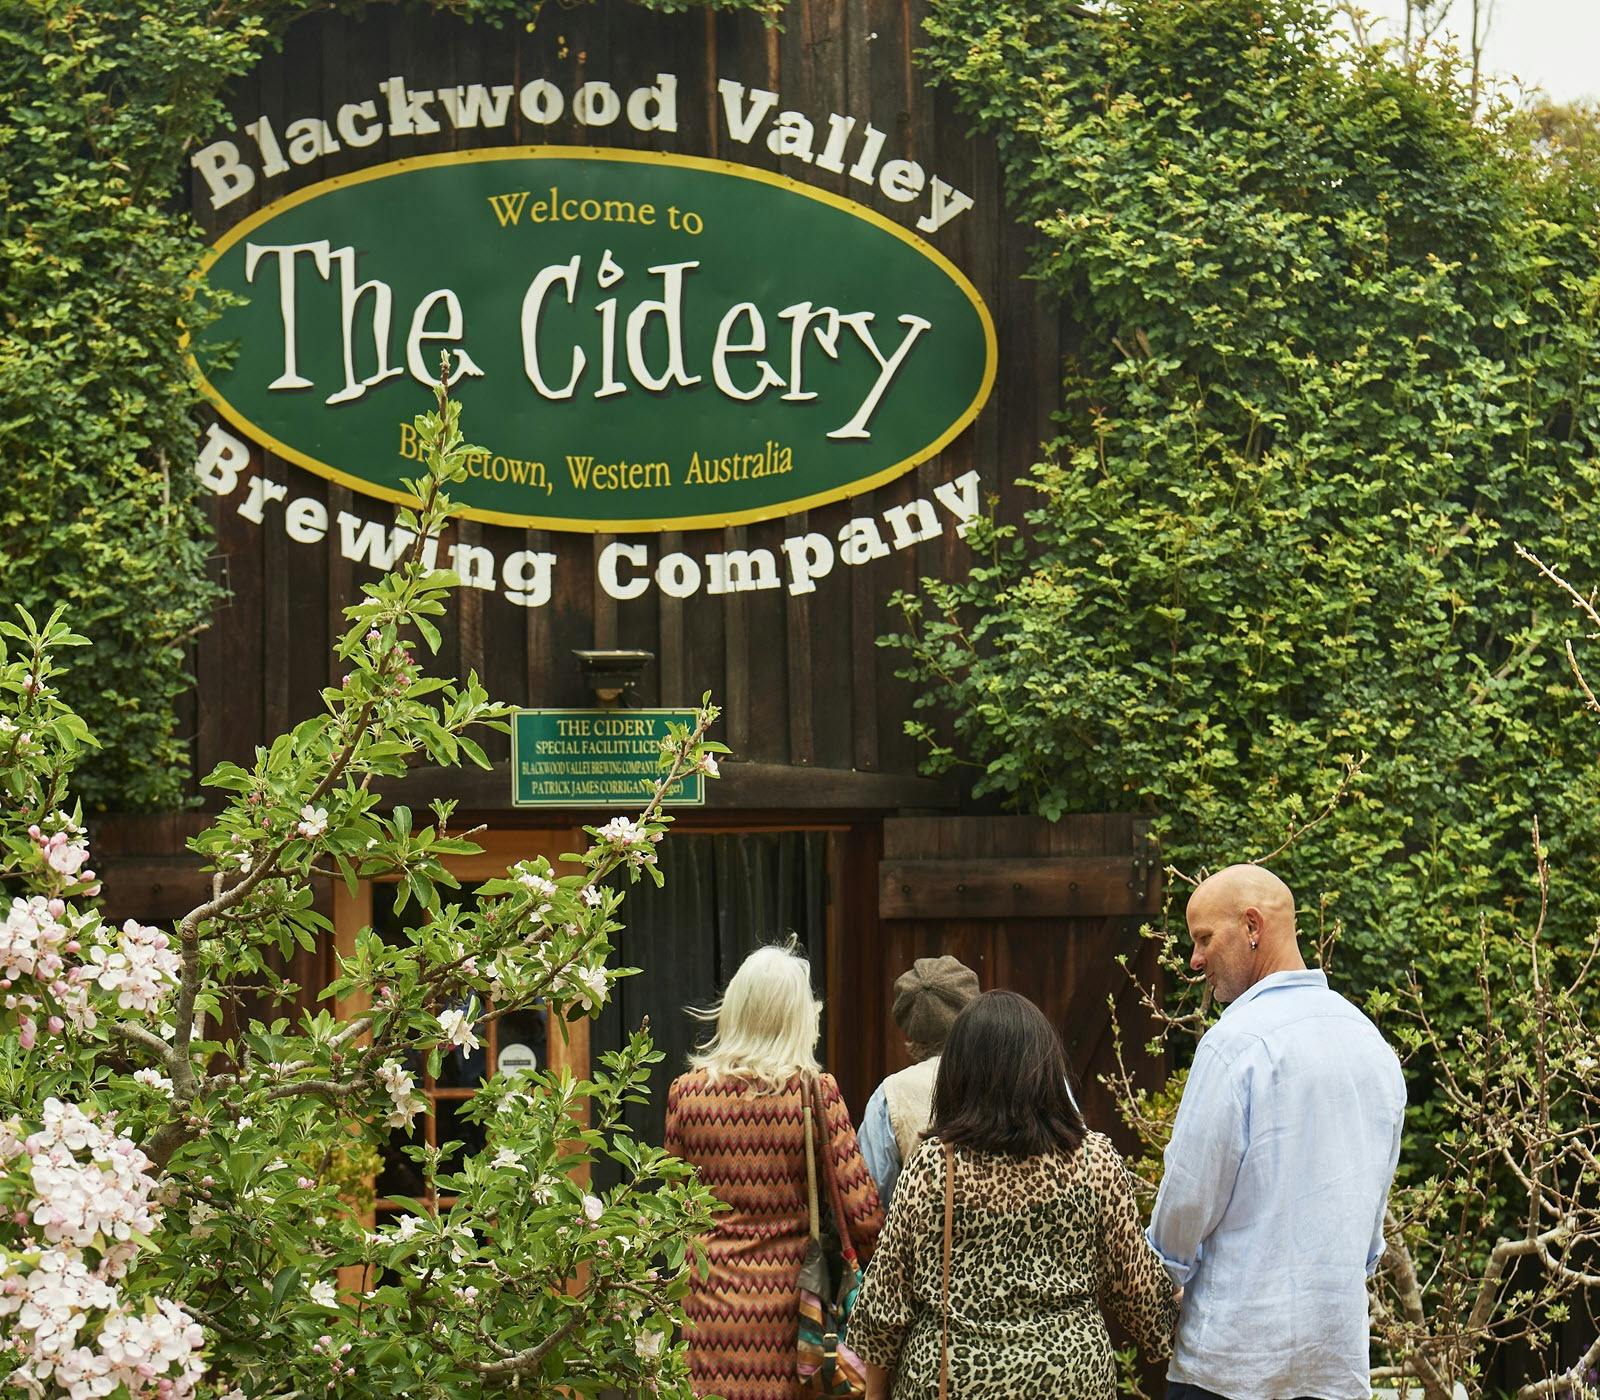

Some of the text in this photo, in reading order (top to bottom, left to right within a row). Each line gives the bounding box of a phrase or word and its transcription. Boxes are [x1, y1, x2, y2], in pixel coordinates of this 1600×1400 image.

[191, 73, 974, 233] Blackwood Valley
[487, 186, 704, 235] Welcome to
[245, 239, 932, 439] The Cidery
[565, 455, 671, 490] Western
[684, 440, 794, 485] Australia
[195, 422, 982, 608] Brewing Company
[535, 740, 580, 755] SPECIAL
[581, 740, 631, 754] FACILITY
[557, 719, 656, 736] THE CIDERY
[531, 781, 570, 794] PATRICK
[570, 781, 600, 797] JAMES
